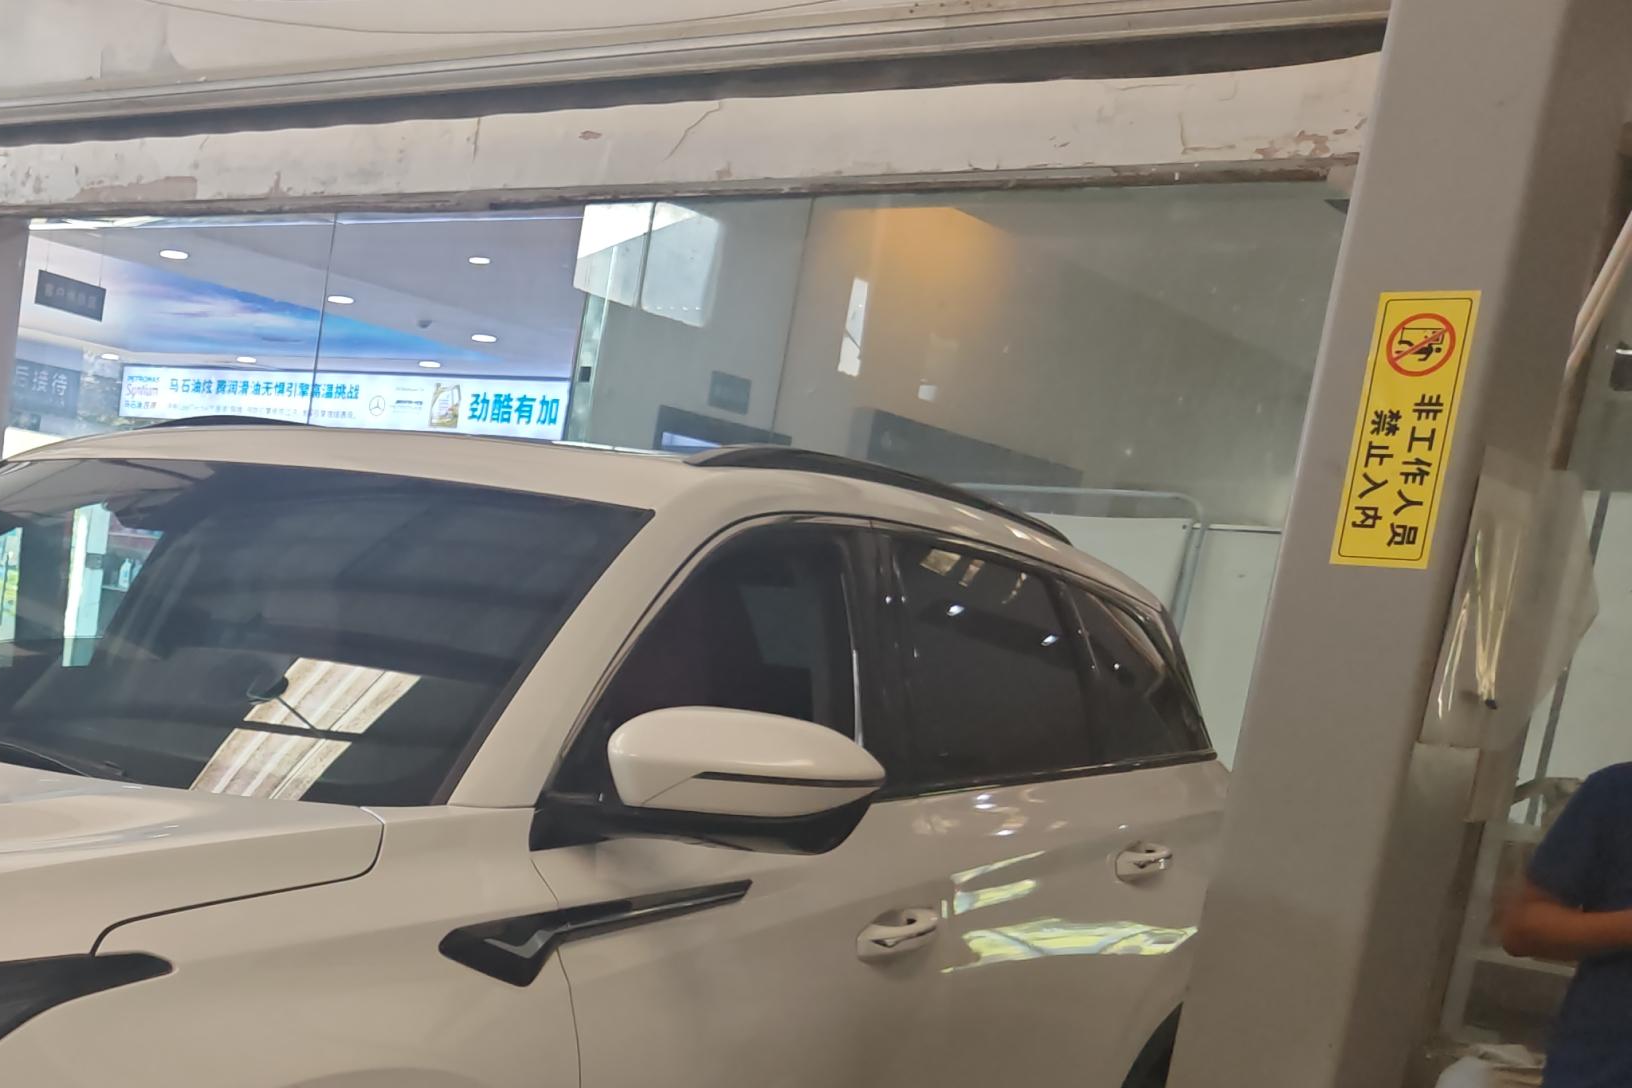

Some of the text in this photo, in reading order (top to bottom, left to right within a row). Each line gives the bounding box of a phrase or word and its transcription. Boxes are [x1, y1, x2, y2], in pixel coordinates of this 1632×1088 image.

[467, 391, 560, 426] 劲酷有加
[1351, 409, 1402, 529] 禁止入内
[1385, 393, 1444, 547] 非工作人员
